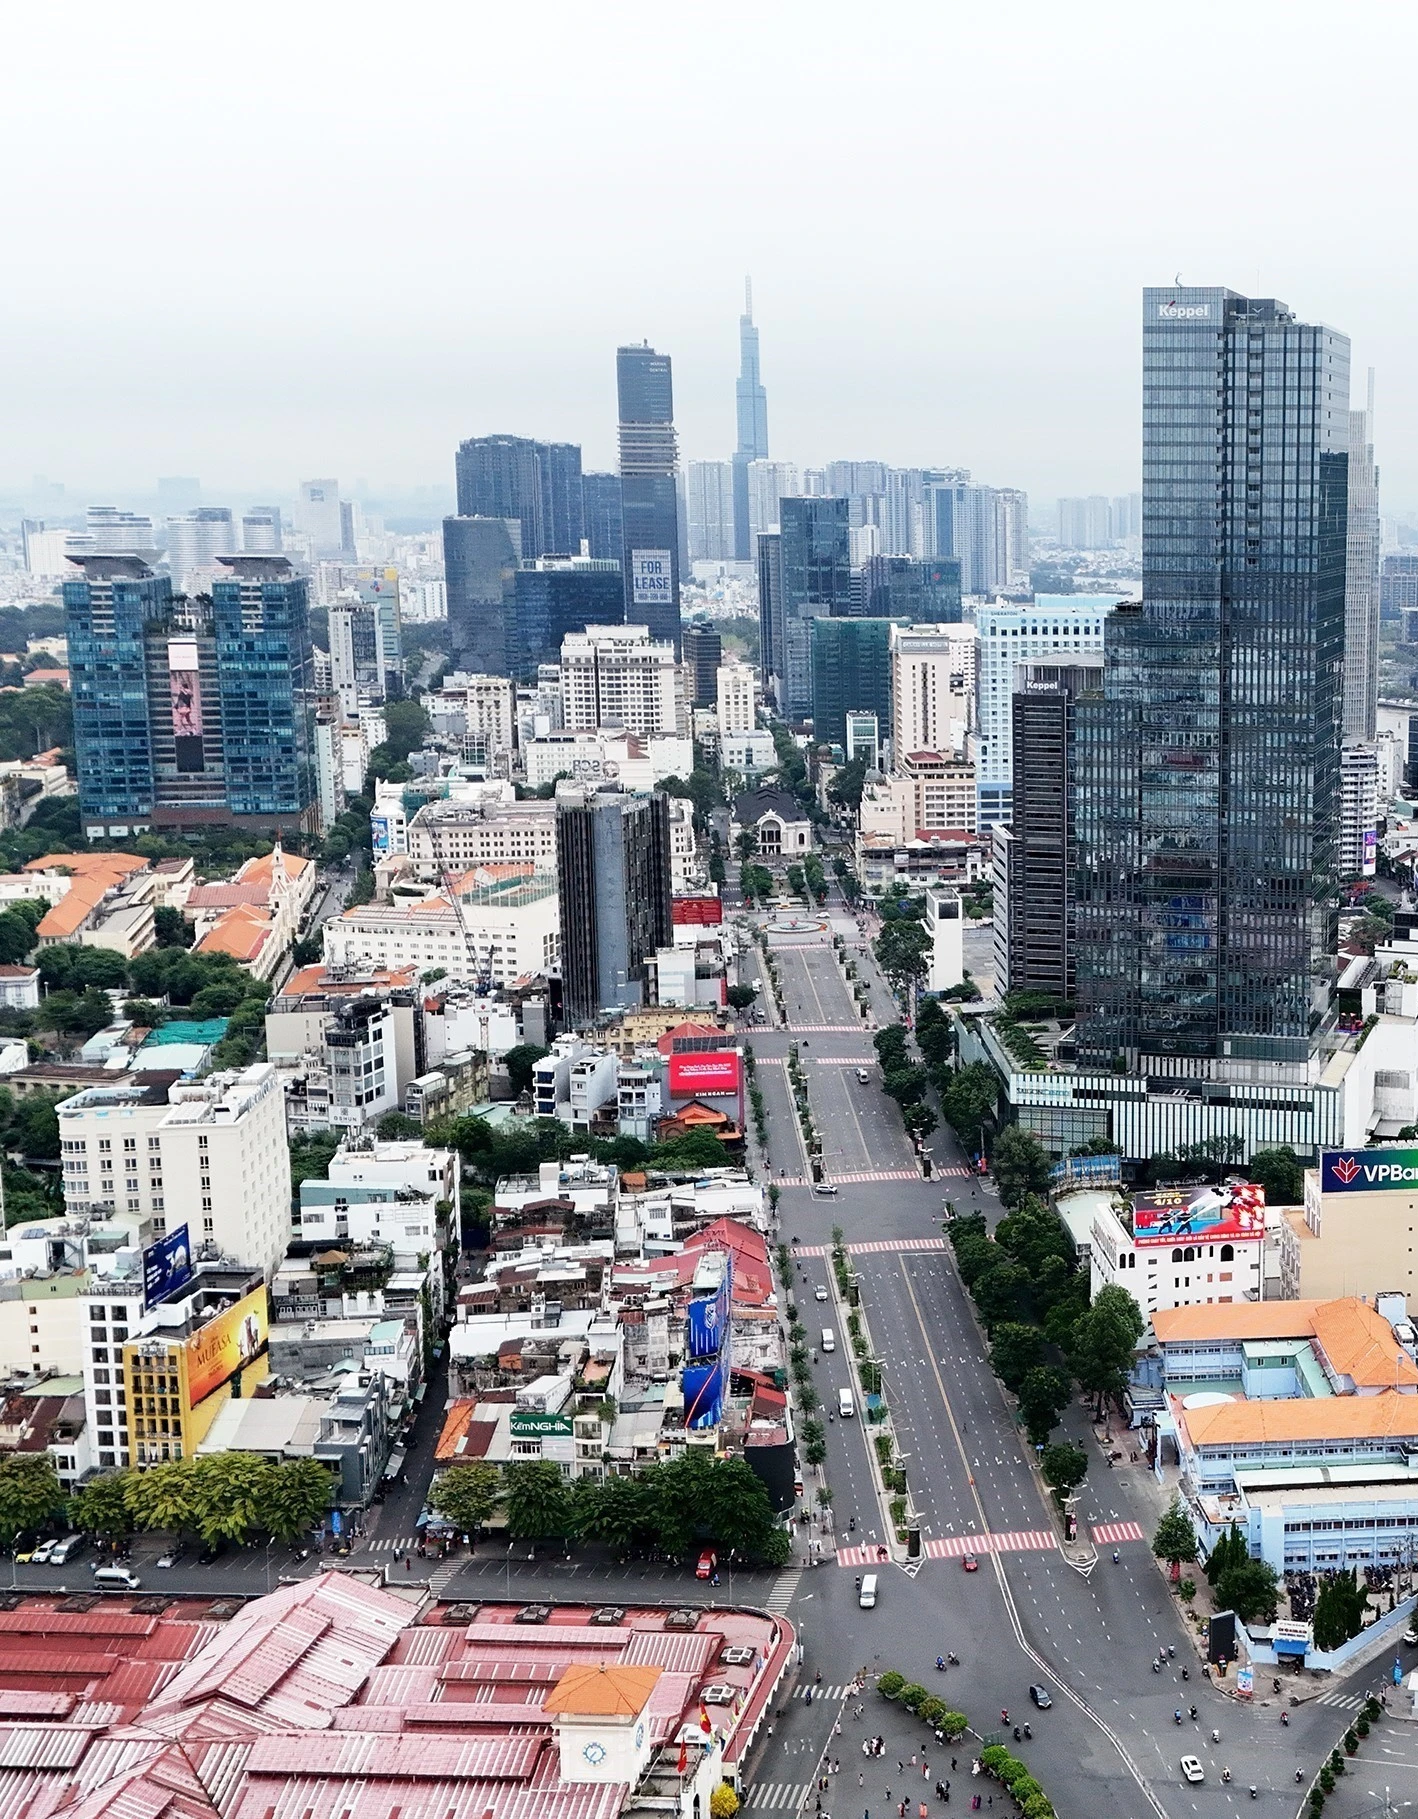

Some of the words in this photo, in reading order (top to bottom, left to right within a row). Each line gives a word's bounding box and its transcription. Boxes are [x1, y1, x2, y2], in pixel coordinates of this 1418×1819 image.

[1159, 303, 1208, 319] Keppel
[641, 561, 661, 573] FOR
[635, 577, 670, 589] LEASE
[1026, 681, 1058, 691] Keppel
[1153, 1197, 1183, 1206] 4/10
[197, 1334, 231, 1368] MUFASA
